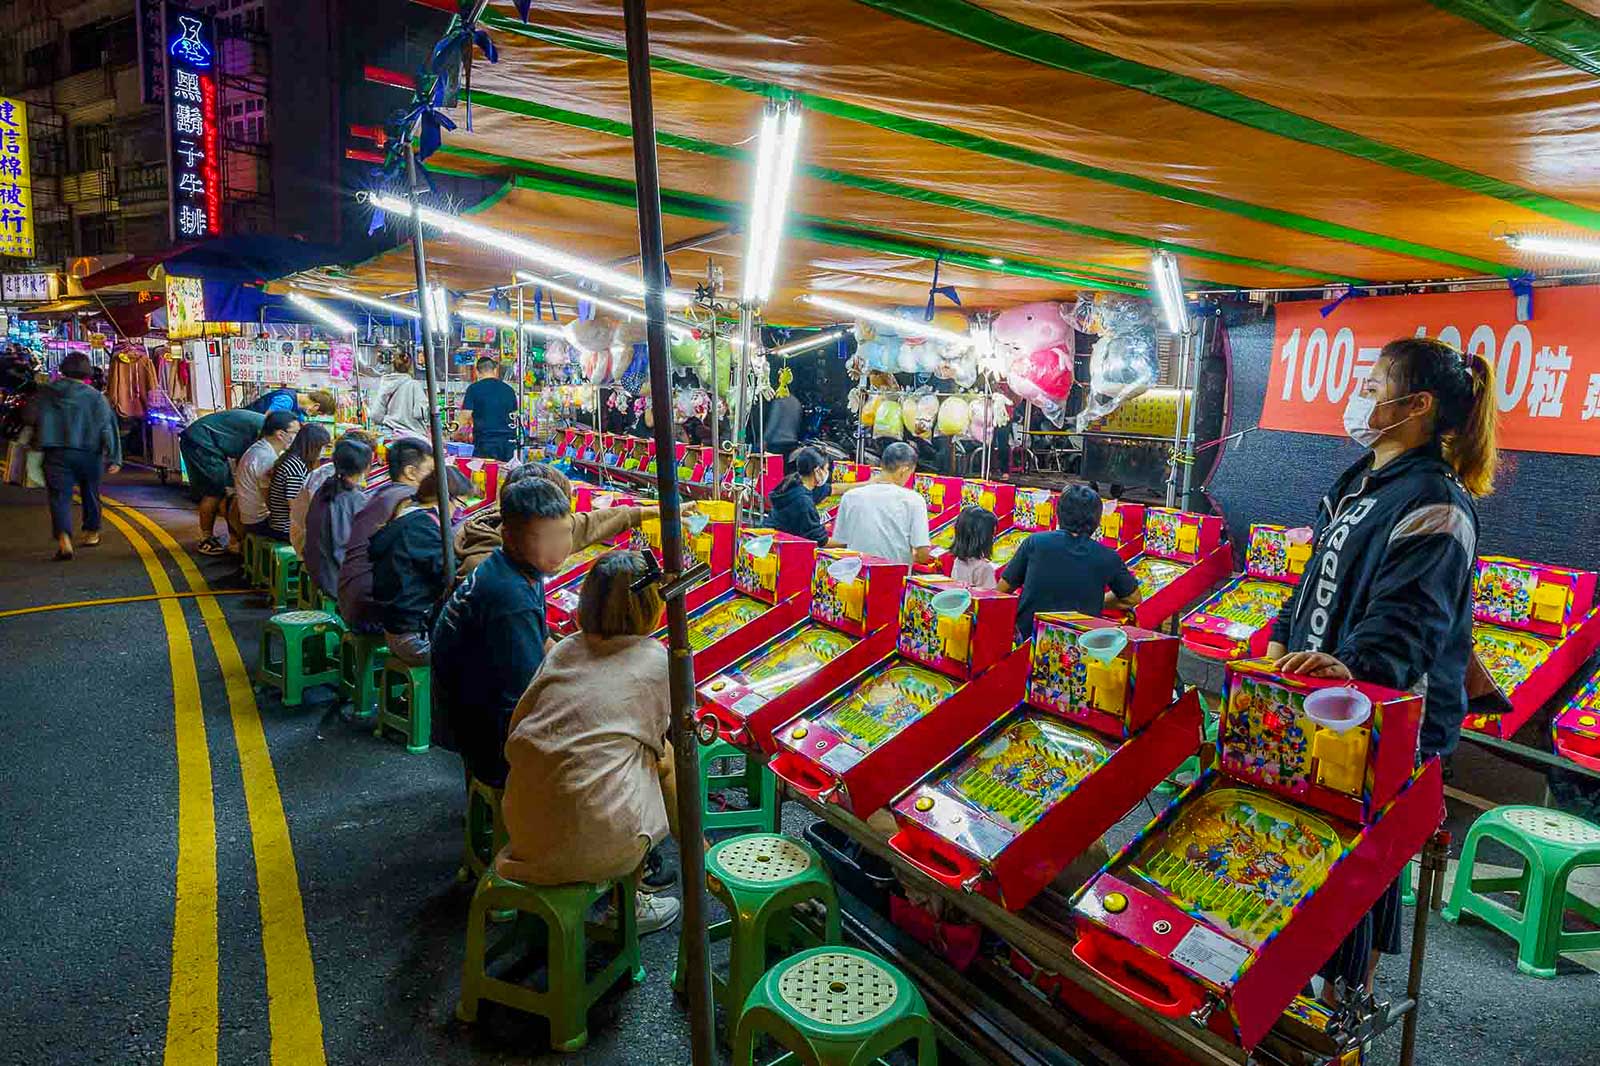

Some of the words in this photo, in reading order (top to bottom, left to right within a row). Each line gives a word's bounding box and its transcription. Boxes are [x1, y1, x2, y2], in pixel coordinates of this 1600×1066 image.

[0, 100, 26, 233] 建信棉被行
